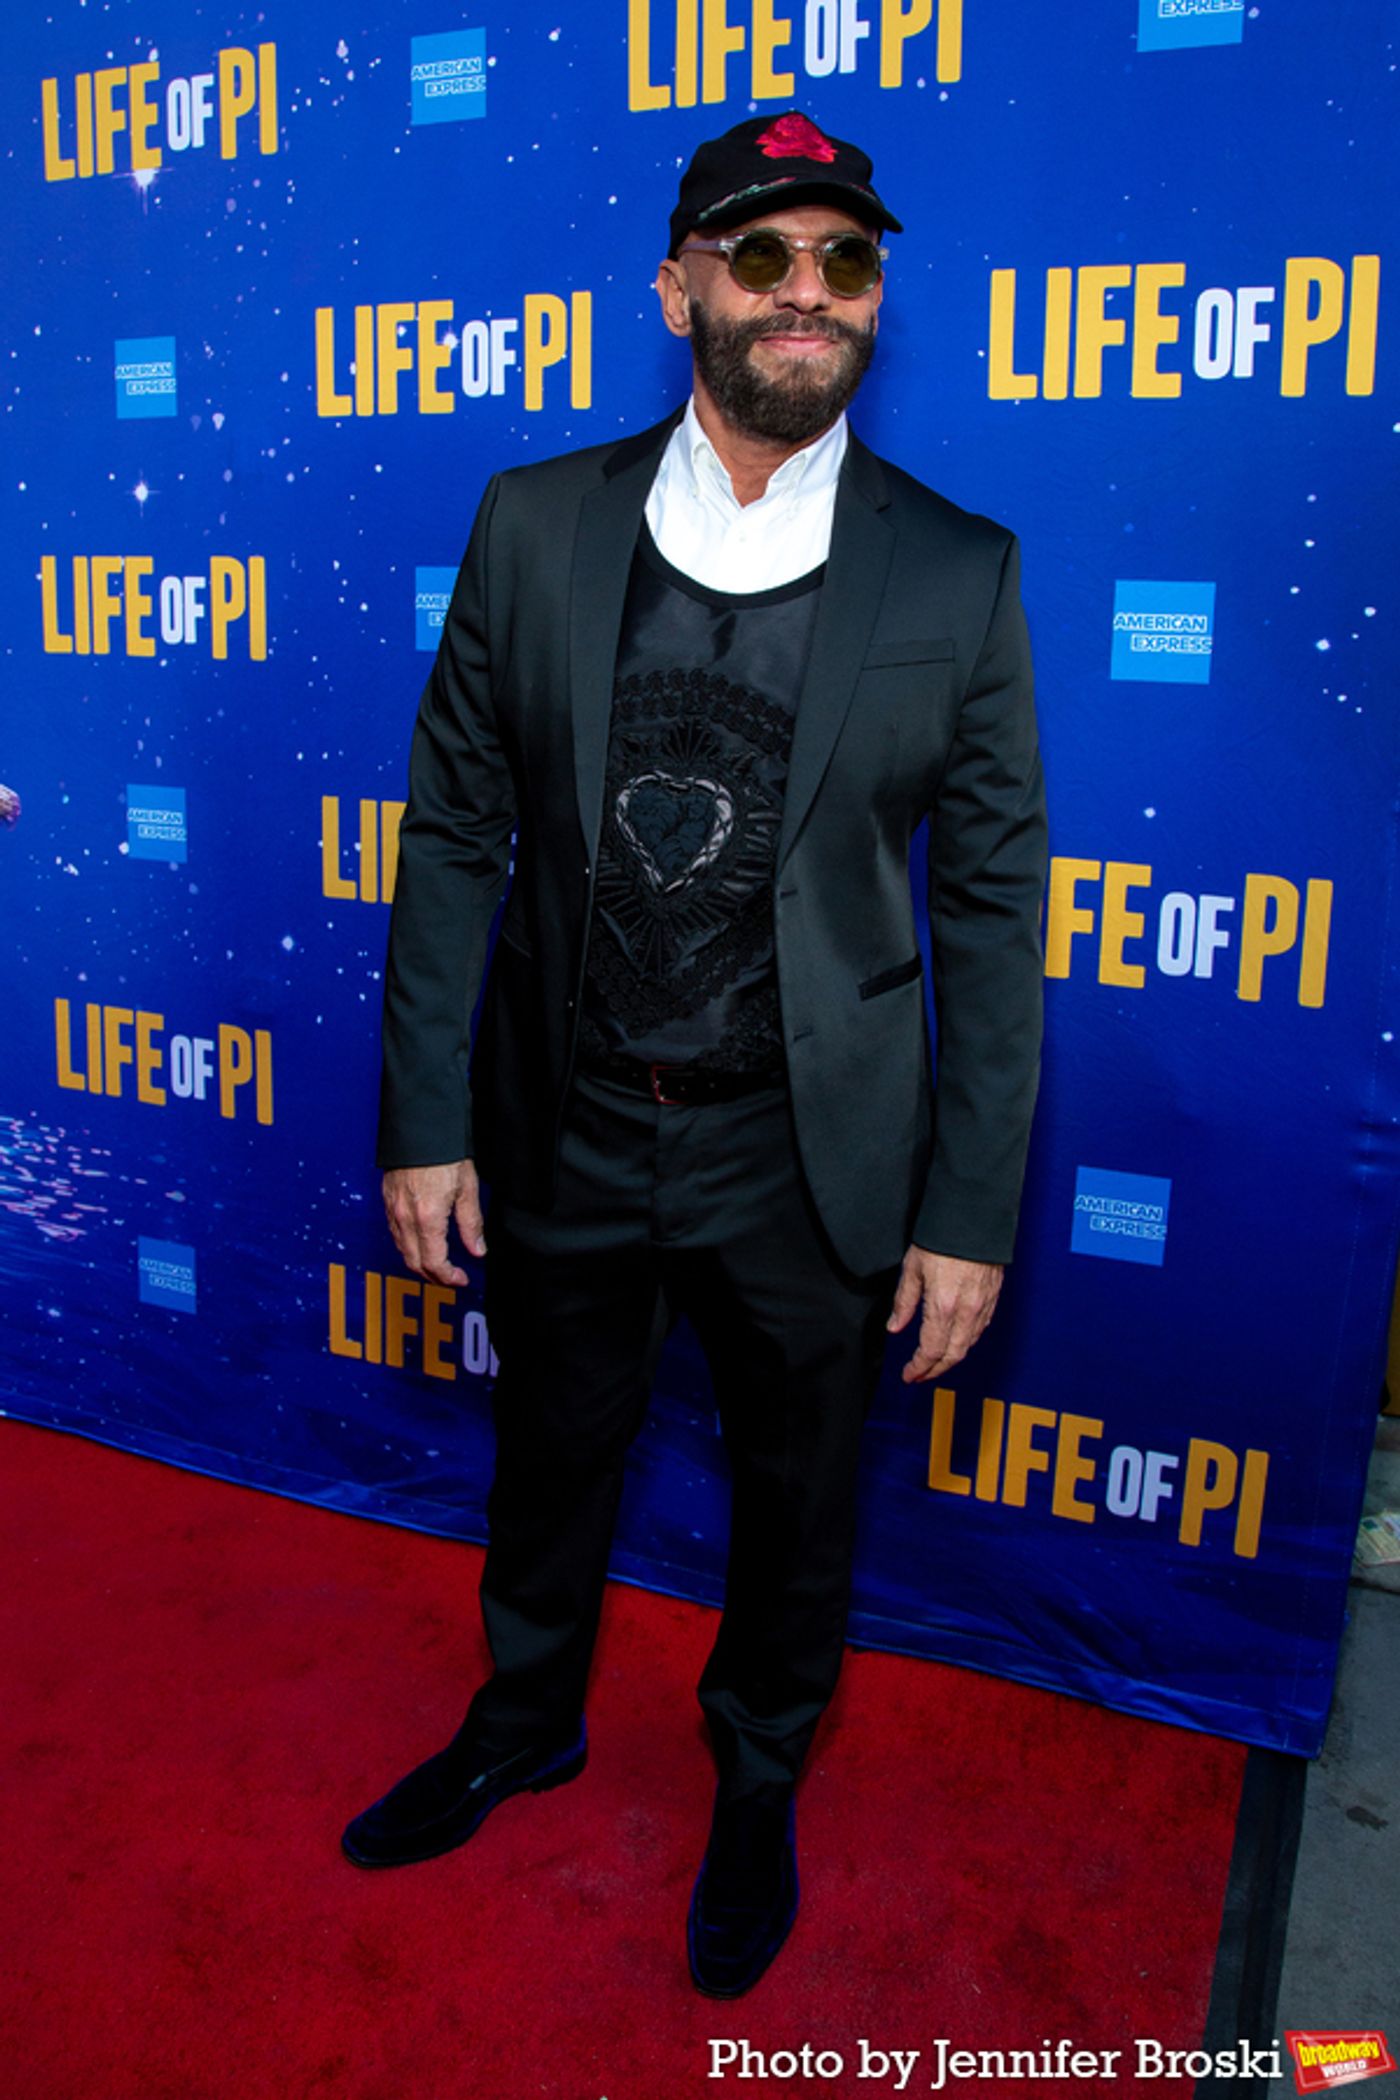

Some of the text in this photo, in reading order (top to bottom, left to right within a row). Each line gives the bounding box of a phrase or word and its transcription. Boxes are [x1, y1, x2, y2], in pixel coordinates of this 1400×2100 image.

[411, 57, 482, 80] AMERICAN
[424, 75, 486, 97] EXPRESS
[629, 0, 963, 111] LIFE OF PI
[42, 43, 277, 181] LIFE OF PI
[316, 291, 592, 417] LIFE OF PI
[988, 255, 1380, 399] LIFE OF PI
[41, 556, 267, 661] LIFE OF PI
[1113, 612, 1208, 633] AMERICAN
[1131, 633, 1212, 654] EXPRESS
[322, 796, 407, 904] LIF
[1044, 857, 1333, 1008] FE OF PI
[55, 998, 273, 1125] LIFE OF PI
[1075, 1195, 1163, 1221] AMERICAN
[1090, 1214, 1167, 1240] EXPRESS
[329, 1263, 456, 1381] LIFE
[928, 1387, 1270, 1559] LIFE OF PI
